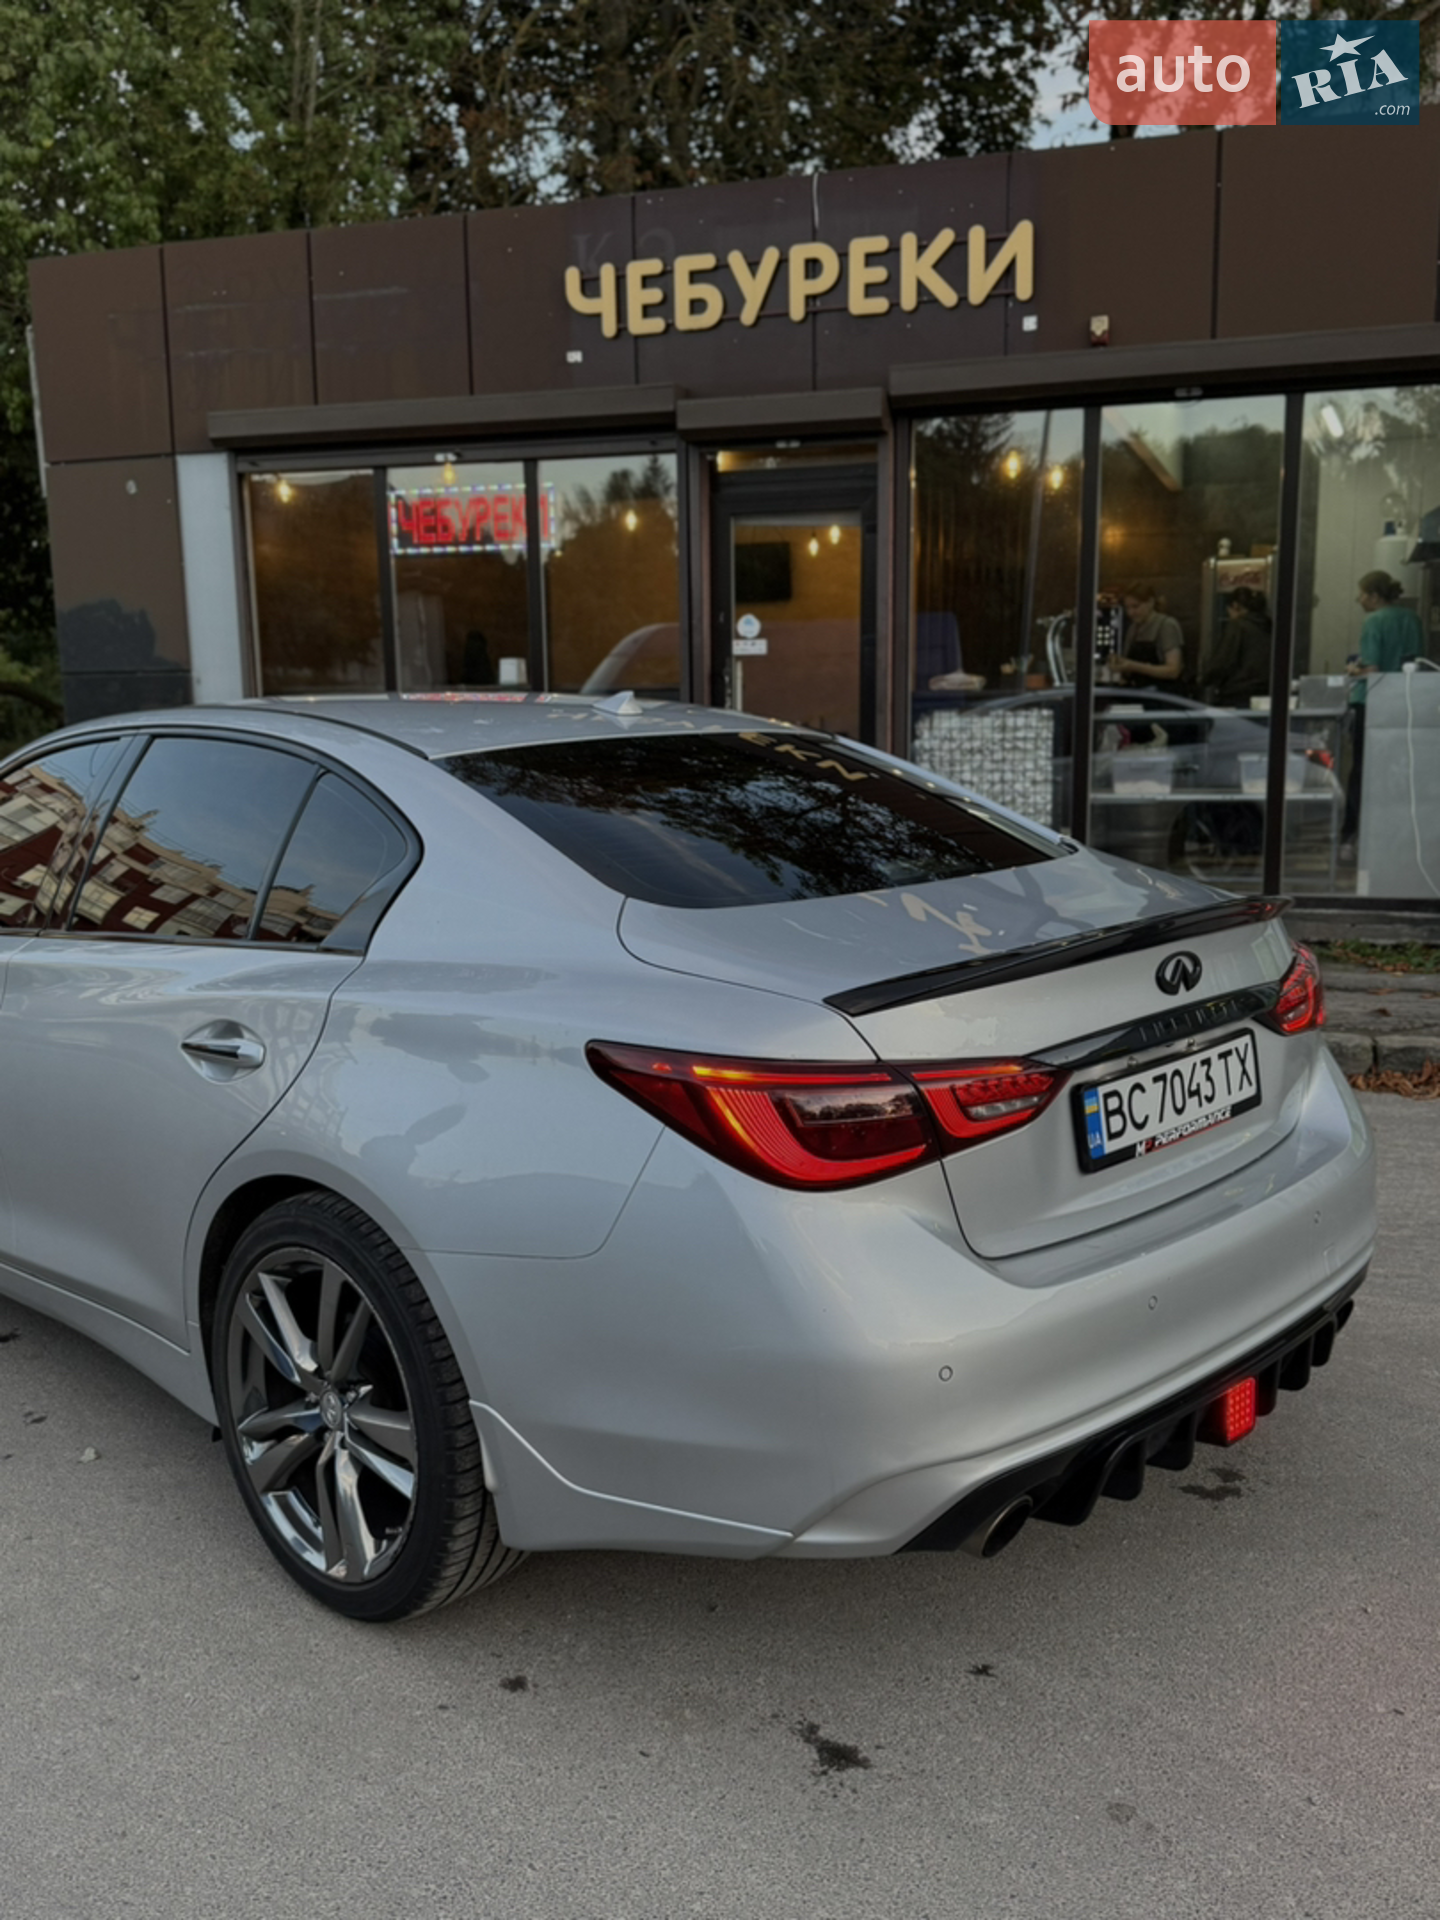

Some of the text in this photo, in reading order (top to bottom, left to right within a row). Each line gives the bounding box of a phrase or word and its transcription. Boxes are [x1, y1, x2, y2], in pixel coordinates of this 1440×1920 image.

[564, 219, 1034, 338] ЧЕБУРЕКИ
[1101, 1042, 1253, 1142] BC 7043 TX
[1154, 1105, 1233, 1148] PERFORMANCE
[1087, 1131, 1102, 1148] UA
